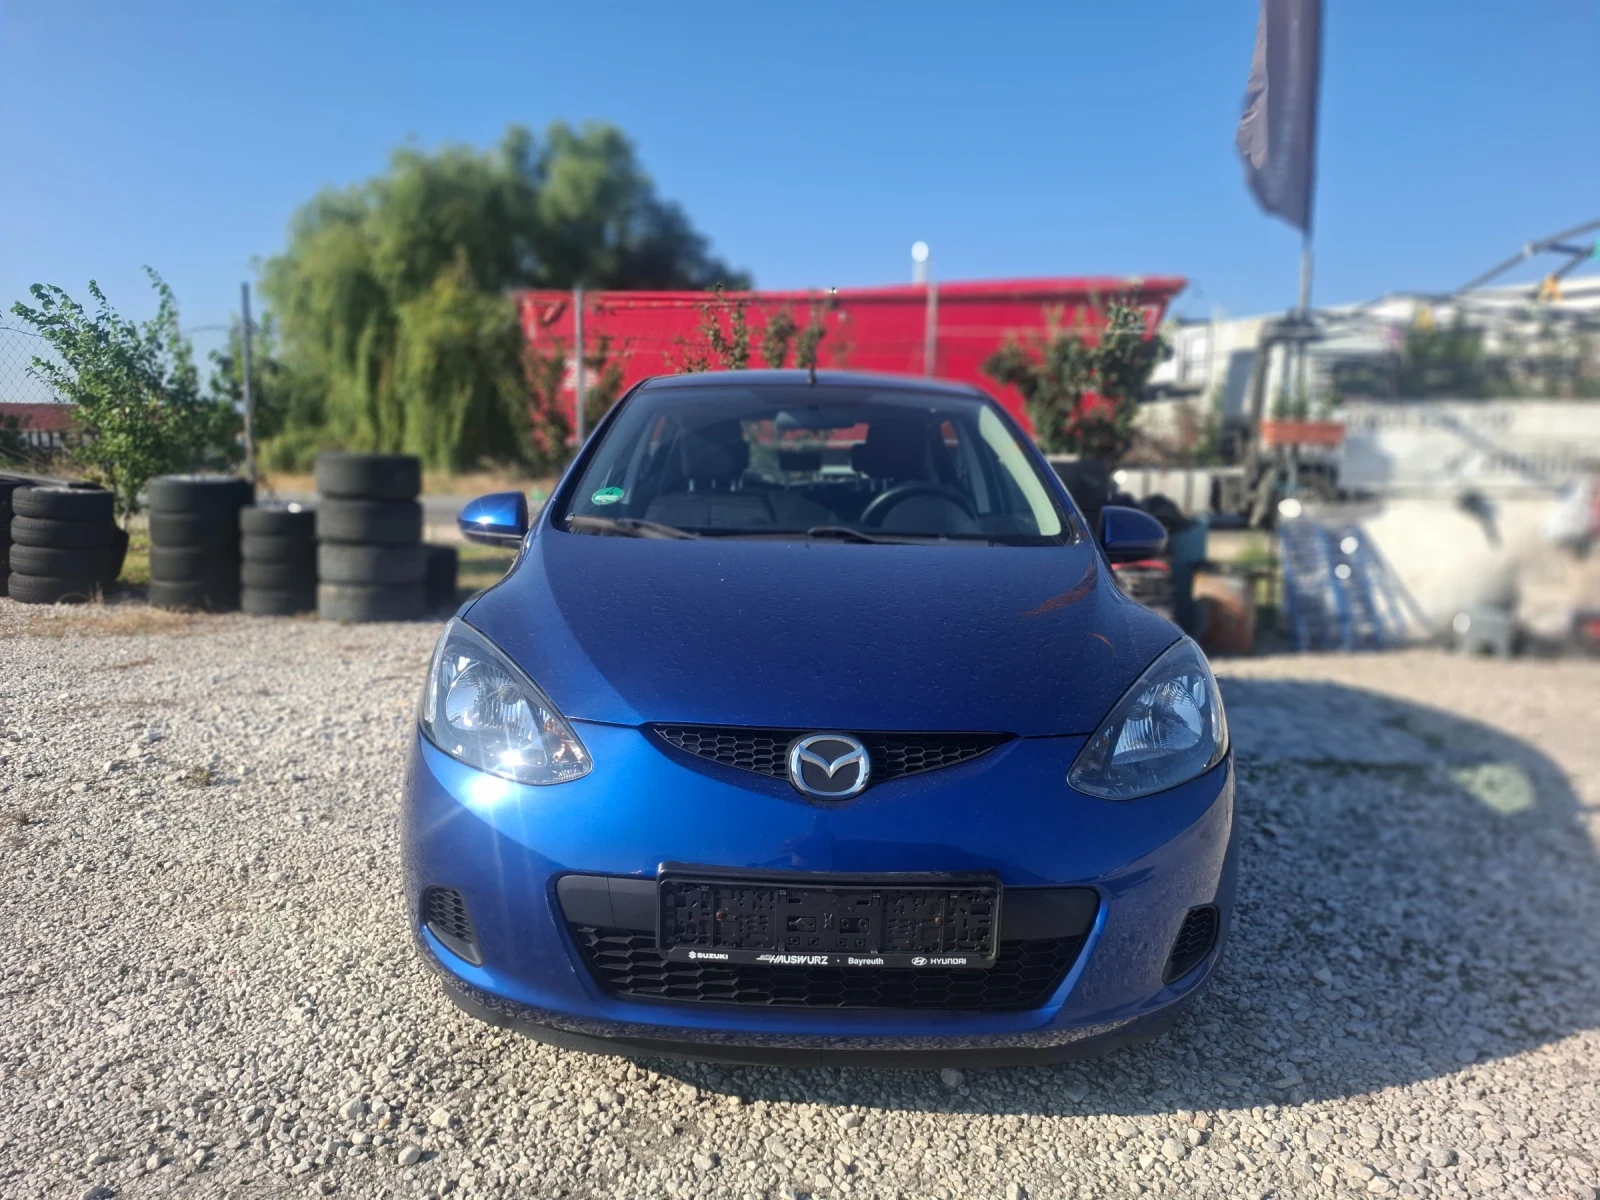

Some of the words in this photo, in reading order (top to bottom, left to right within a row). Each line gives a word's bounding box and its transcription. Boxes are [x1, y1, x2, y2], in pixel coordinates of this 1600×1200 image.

[697, 952, 729, 960] SUZUKI
[847, 957, 884, 967] Bayreuth
[930, 957, 967, 965] HYUNDAI
